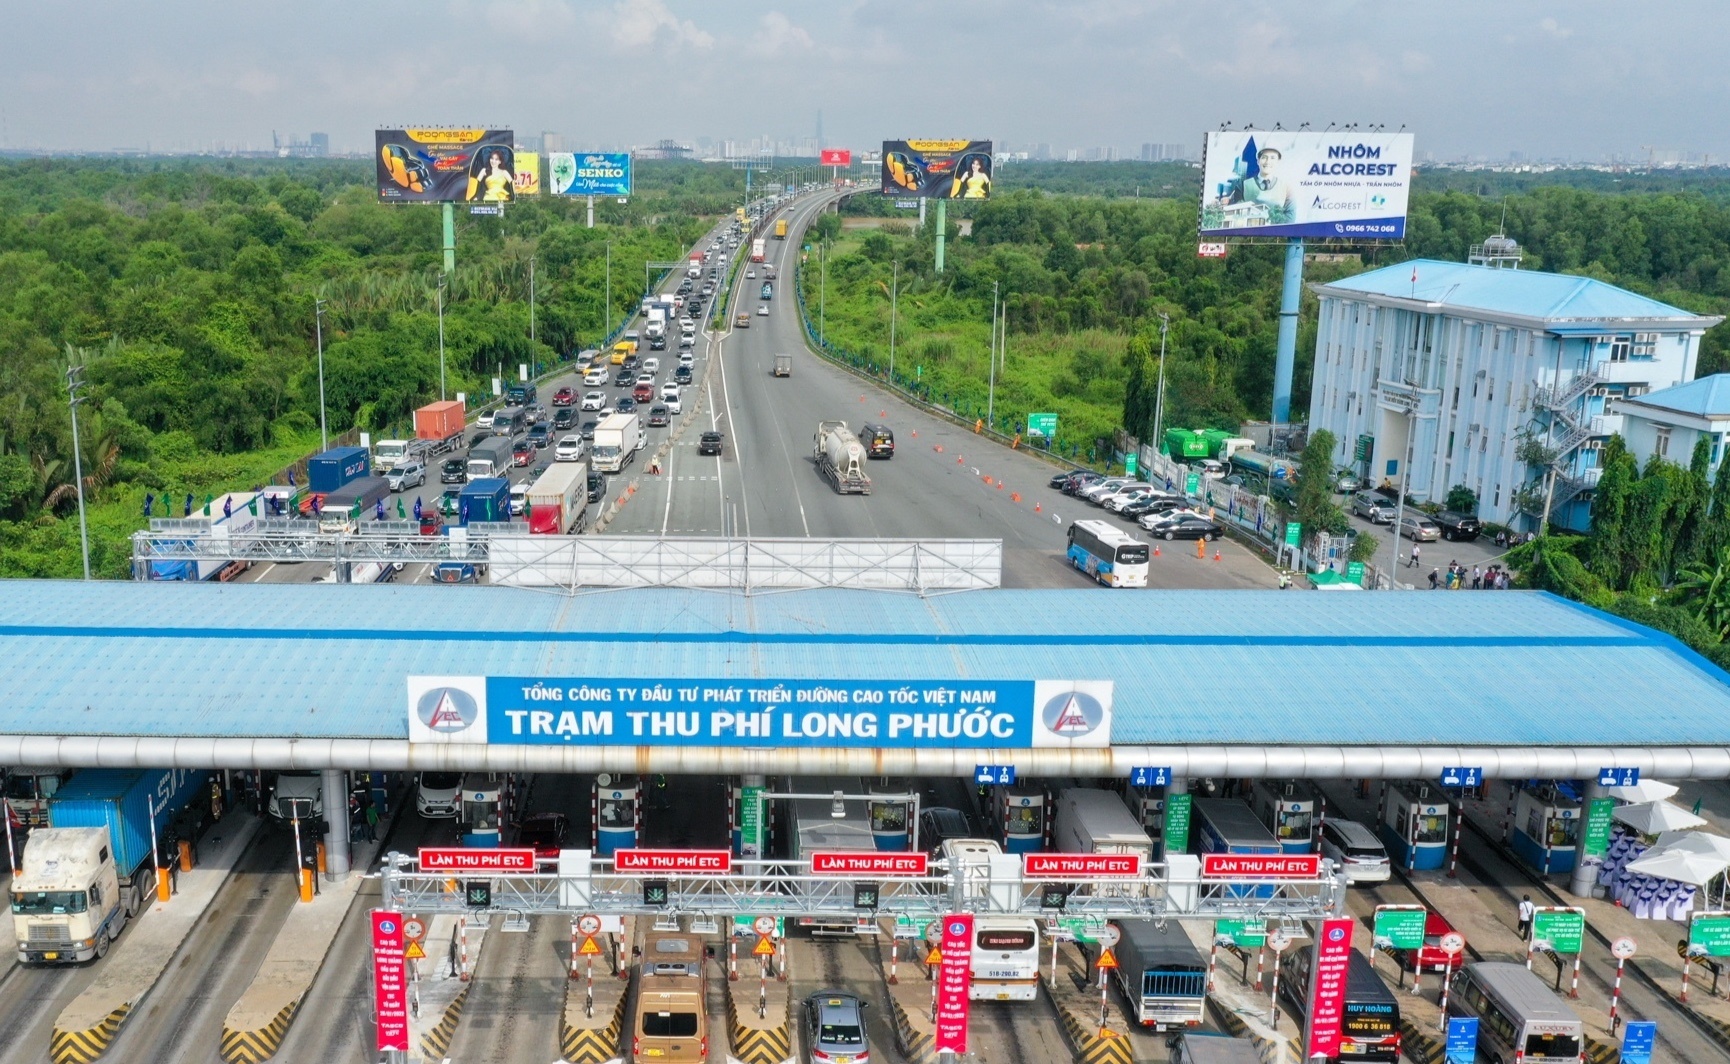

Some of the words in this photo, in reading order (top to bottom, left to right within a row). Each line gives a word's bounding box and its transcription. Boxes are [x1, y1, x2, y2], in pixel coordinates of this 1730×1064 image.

[1328, 144, 1381, 159] NHÔM
[578, 168, 623, 178] SENKO
[1308, 163, 1397, 176] ALCOREST
[1312, 195, 1361, 209] ALCOREST
[522, 682, 562, 701] TỔNG
[569, 684, 611, 702] CÔNG
[617, 688, 637, 702] TY
[642, 683, 672, 702] ĐẦU
[678, 688, 698, 702] TƯ
[704, 686, 742, 702] PHÁT
[748, 684, 791, 703] TRIỂN
[797, 686, 848, 703] ĐƯỜNG
[853, 690, 882, 703] CAO
[888, 686, 918, 703] TỐC
[923, 688, 954, 706] VIỆT
[961, 690, 996, 703] NAM
[505, 710, 612, 740] TRẠM
[626, 712, 699, 736] THU
[711, 706, 772, 737] PHÍ
[783, 712, 877, 738] LONG
[888, 706, 1014, 738] PHƯỚC
[430, 854, 453, 865] LÀN
[456, 856, 478, 865] THU
[482, 854, 501, 865] PHÍ
[504, 856, 524, 866] ETC
[625, 855, 648, 866] LÀN
[651, 857, 674, 866] THU
[677, 855, 697, 866] PHÍ
[700, 857, 720, 866] ETC
[822, 857, 845, 868] LÀN
[848, 859, 871, 868] THU
[874, 858, 894, 868] PHÍ
[896, 860, 916, 869] ETC
[1035, 859, 1058, 870] LÀN
[1061, 861, 1084, 870] THU
[1087, 860, 1106, 870] PHÍ
[1109, 862, 1129, 870] ETC
[1214, 860, 1237, 870] LÀN
[1240, 862, 1263, 870] THU
[1266, 860, 1286, 871] PHÍ
[1288, 862, 1308, 871] ETC
[1365, 1004, 1392, 1012] HOÀNG
